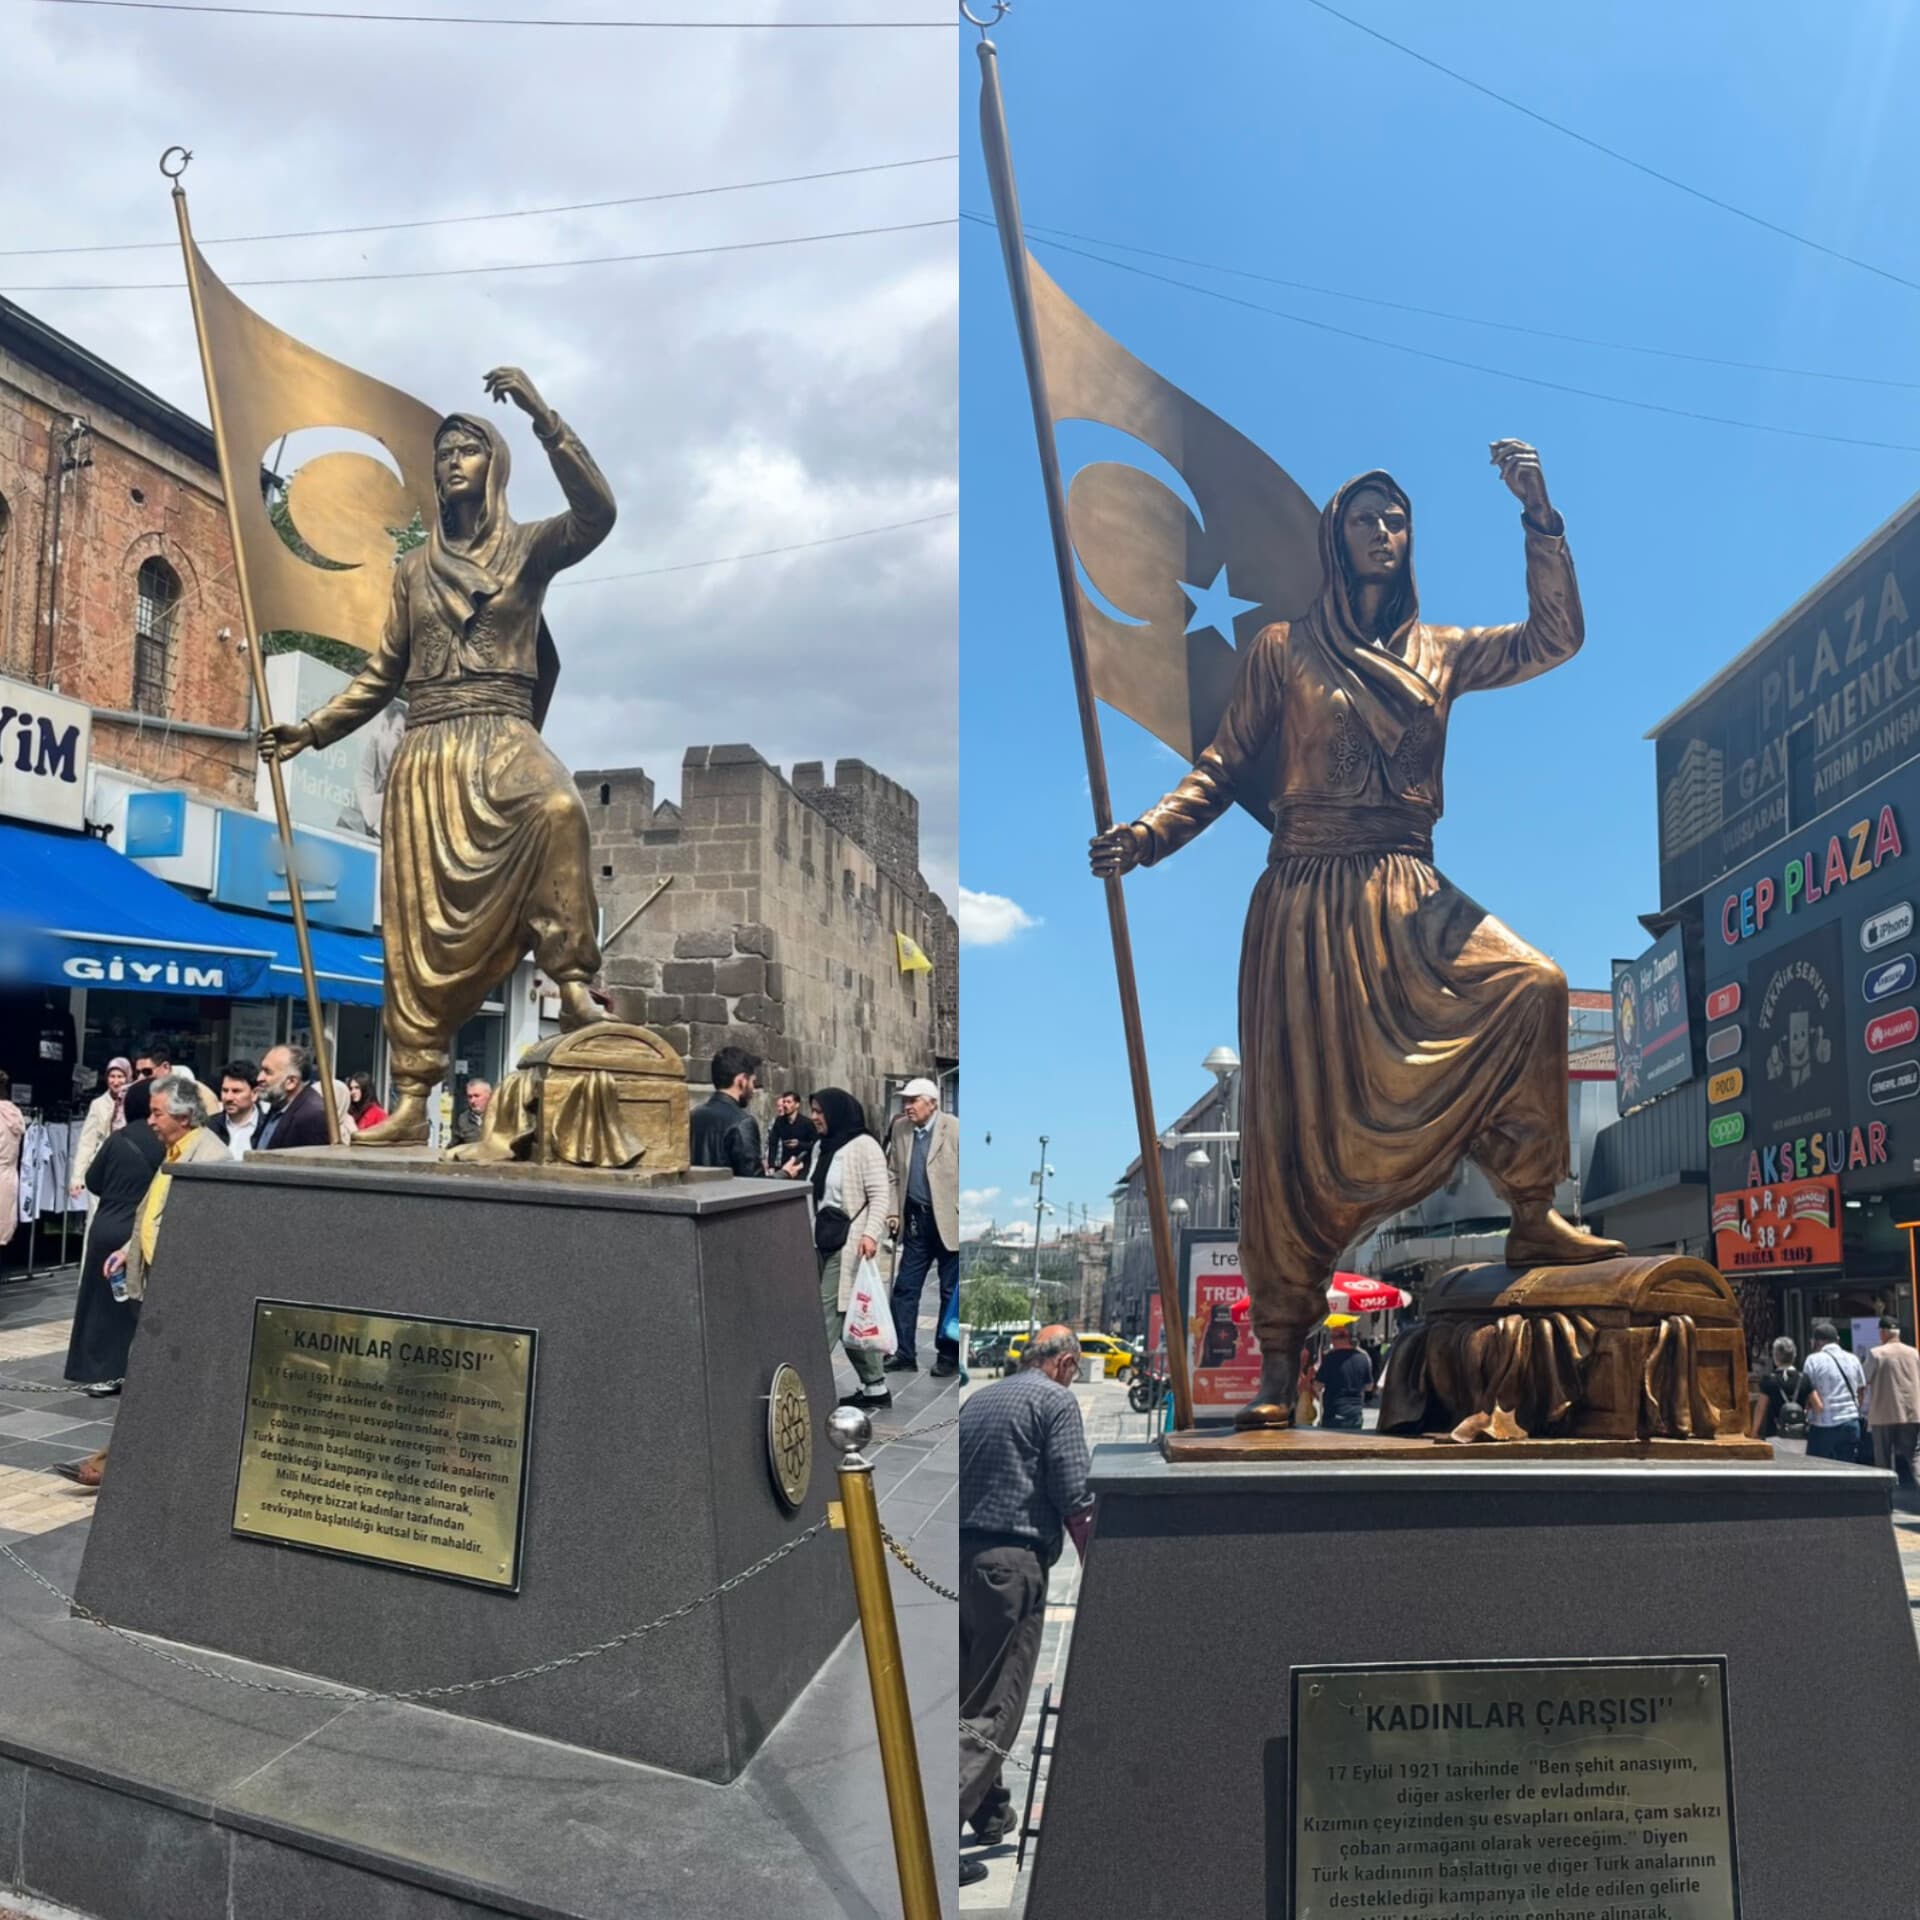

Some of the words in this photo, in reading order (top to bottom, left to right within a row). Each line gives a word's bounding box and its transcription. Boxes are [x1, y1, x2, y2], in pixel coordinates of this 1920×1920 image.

[1762, 572, 1909, 731] PLAZA
[1722, 877, 1774, 945] CEP
[1784, 804, 1902, 914] PLAZA
[1879, 914, 1911, 938] iPhone
[63, 956, 223, 987] GİYİM
[1715, 1076, 1736, 1095] POCO
[1714, 1119, 1740, 1141] oppo
[1747, 1121, 1887, 1187] AKSESUAR
[1757, 1225, 1776, 1248] 38
[336, 1393, 377, 1409] askerler
[380, 1400, 393, 1411] de
[353, 1430, 386, 1445] olarak
[377, 1452, 391, 1463] ve
[324, 1459, 378, 1480] kampanya
[397, 1474, 420, 1487] elde
[280, 1488, 323, 1504] cepheye
[325, 1495, 358, 1511] bizzat
[360, 1501, 404, 1518] kadınlar
[407, 1511, 464, 1531] tarafından
[375, 1488, 421, 1506] cephane
[260, 1500, 313, 1519] sevkiyatın
[376, 1521, 410, 1539] kutsal
[413, 1529, 428, 1542] bir
[1327, 1765, 1347, 1781] 17
[1353, 1763, 1392, 1784] Eylül
[1400, 1763, 1439, 1779] 1921
[1446, 1760, 1520, 1777] tarihinde
[1575, 1755, 1614, 1777] şehit
[1619, 1756, 1698, 1774] anasıyım,
[1397, 1787, 1440, 1807] diğer
[1445, 1785, 1511, 1802] askerler
[1516, 1783, 1536, 1799] de
[1541, 1781, 1631, 1799] evladımdır.
[1304, 1816, 1368, 1833] Kızımın
[1373, 1812, 1463, 1835] çeyizinden
[1468, 1813, 1488, 1831] şu
[1494, 1807, 1568, 1828] esvapları
[1573, 1806, 1630, 1824] onlara,
[1634, 1807, 1668, 1825] çam
[1673, 1803, 1721, 1819] sakızı
[1339, 1840, 1391, 1861] çoban
[1396, 1836, 1476, 1857] armağanı
[1481, 1834, 1532, 1851] olarak
[1643, 1829, 1688, 1848] Diyen
[1312, 1865, 1349, 1883] Türk
[1354, 1863, 1433, 1881] kadınının
[1439, 1859, 1518, 1882] başlattığı
[1522, 1860, 1541, 1874] ve
[1547, 1856, 1588, 1878] diğer
[1594, 1855, 1630, 1872] Türk
[1635, 1853, 1716, 1870] analarının
[1329, 1887, 1434, 1909] desteklediği
[1439, 1887, 1526, 1906] kampanya
[1531, 1884, 1554, 1900] ile
[1556, 1882, 1590, 1898] elde
[1595, 1880, 1645, 1897] edilen
[1651, 1877, 1700, 1895] gelirle
